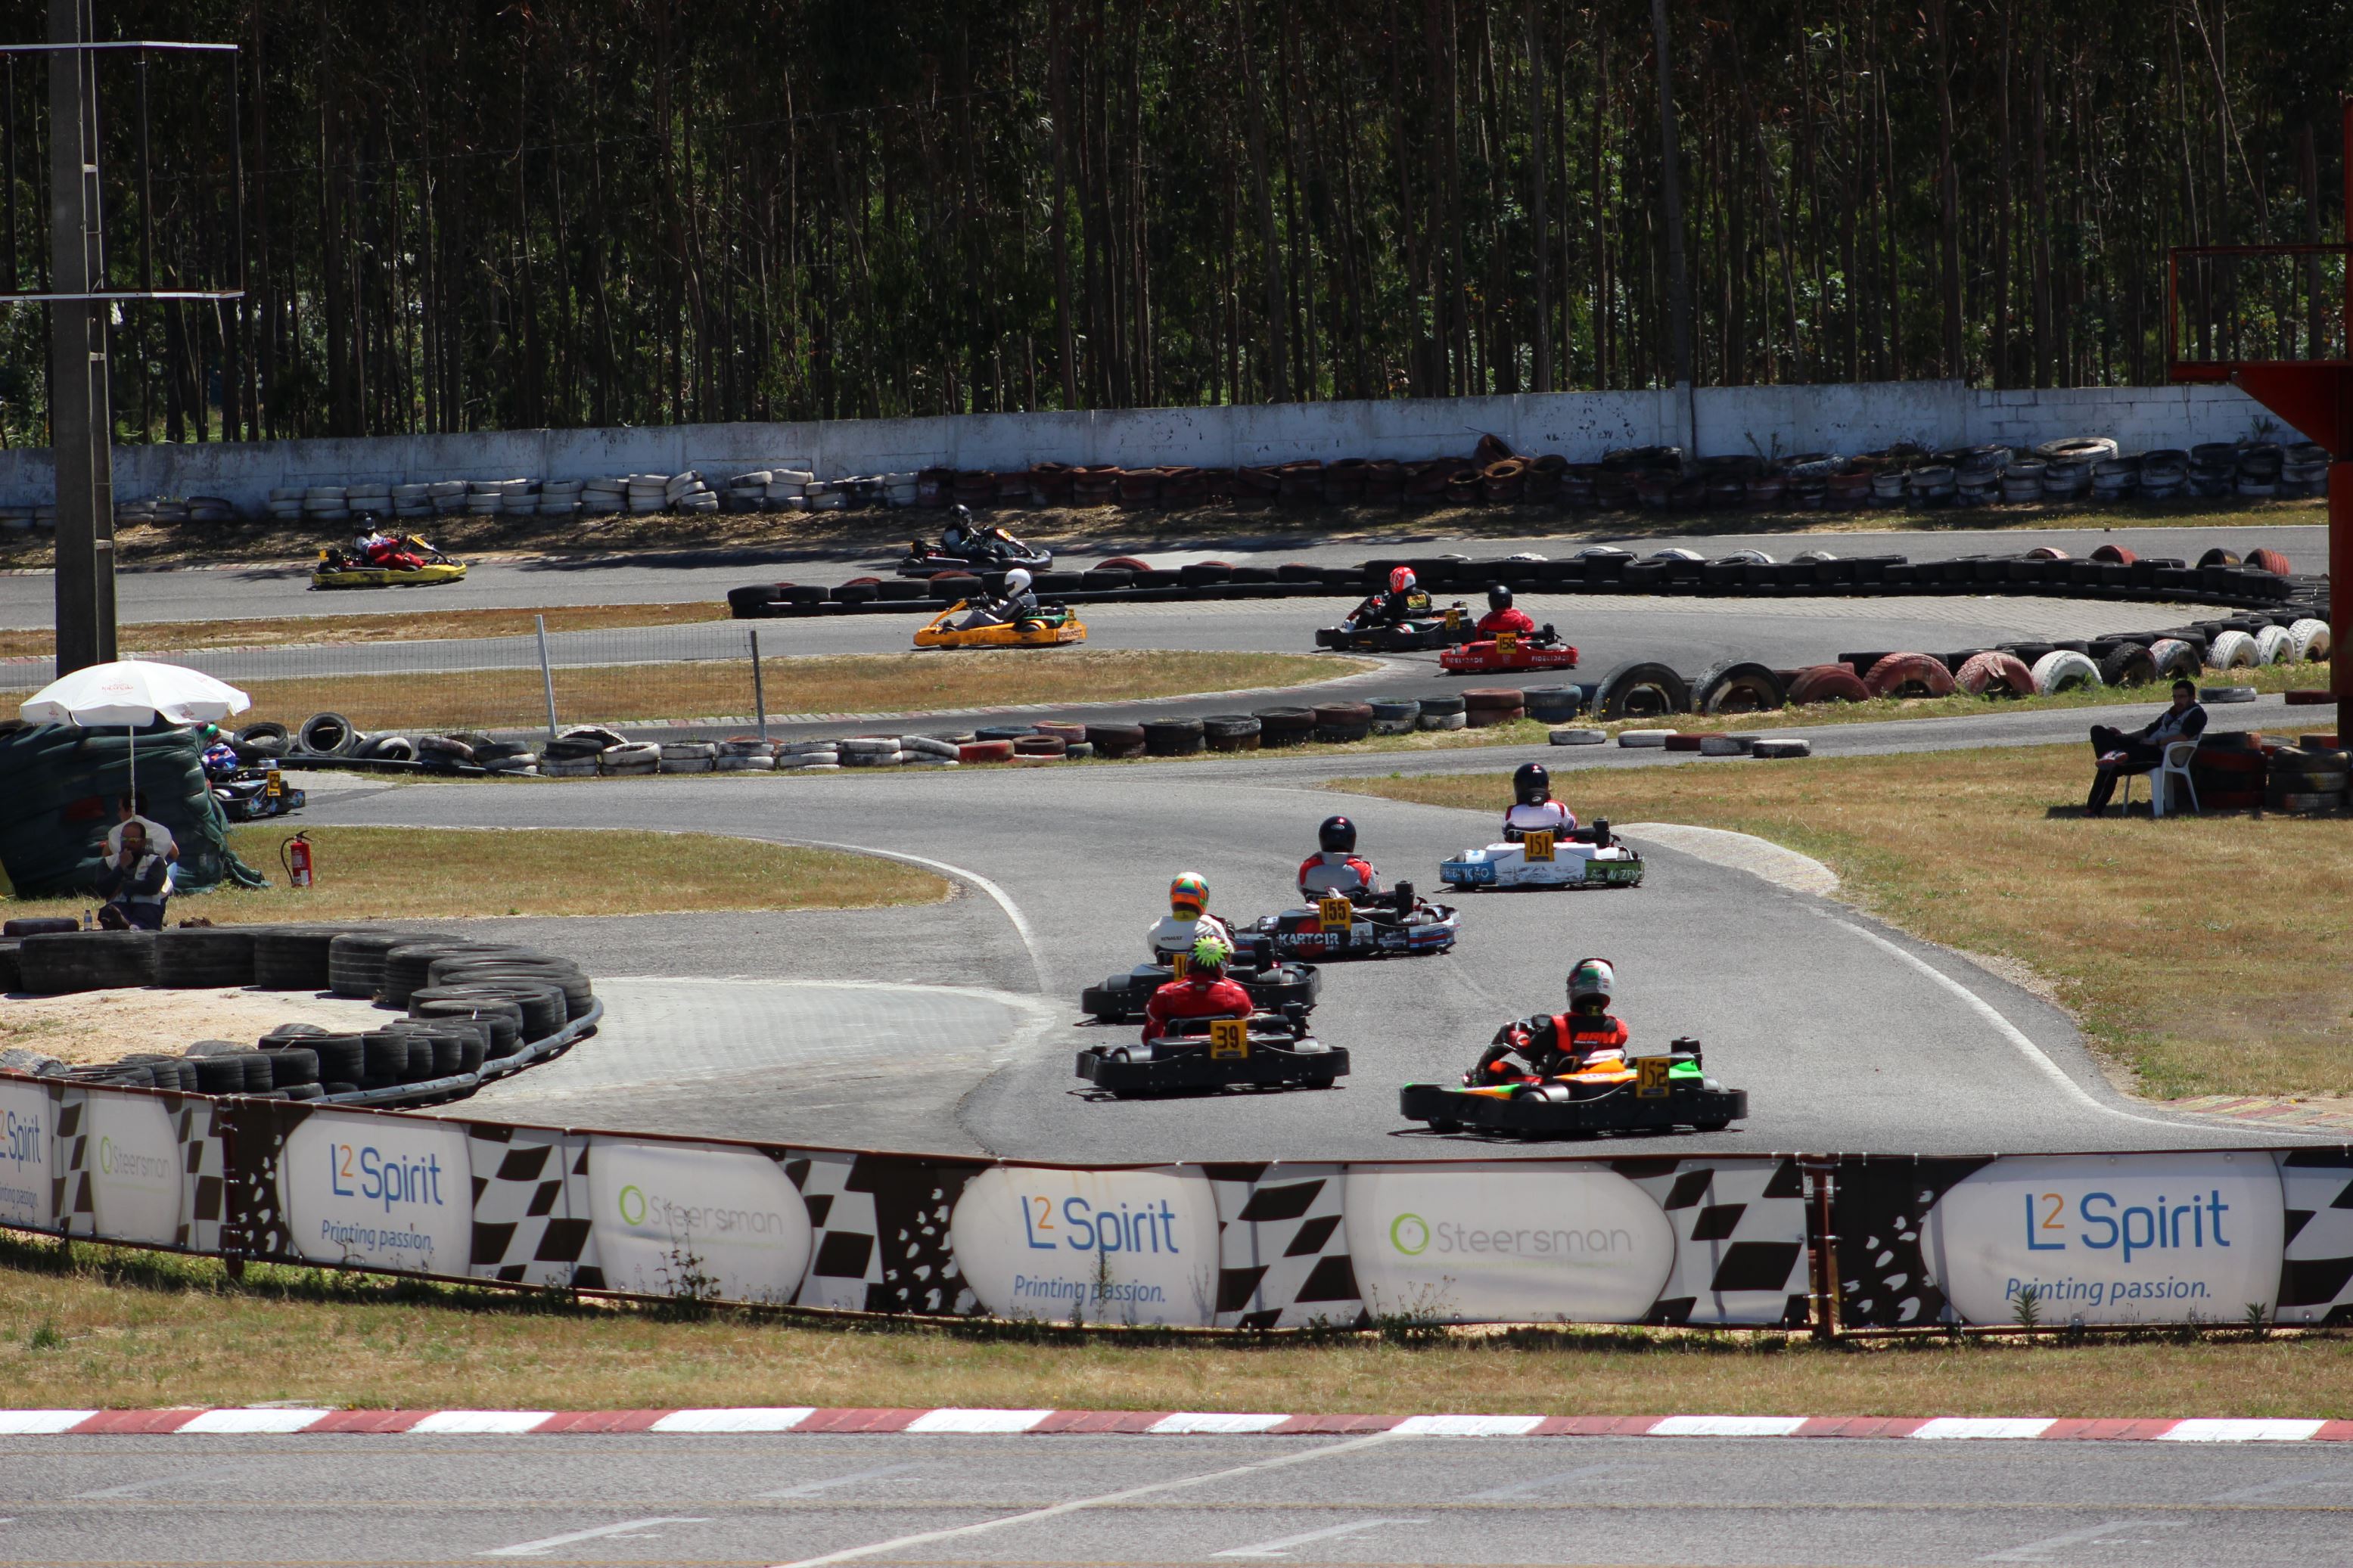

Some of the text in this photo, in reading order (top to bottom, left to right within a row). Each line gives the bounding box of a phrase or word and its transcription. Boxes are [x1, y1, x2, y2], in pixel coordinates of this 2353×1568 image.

[1500, 637, 1516, 650] 158
[1529, 834, 1549, 855] 151
[1323, 901, 1347, 921] 155
[1278, 933, 1339, 945] KARTCIR
[1216, 1025, 1239, 1049] 39
[1641, 1060, 1668, 1088] 152
[8, 1110, 42, 1172] Spirit
[114, 1144, 169, 1178] Steersman
[360, 1147, 443, 1213] Spirit
[650, 1195, 784, 1234] Steersman
[1062, 1197, 1179, 1253] Spirit
[2079, 1188, 2231, 1263] Spirit
[322, 1219, 376, 1251] Printing
[1437, 1222, 1633, 1253] Steersman
[1015, 1275, 1166, 1307] Printing passion.
[2005, 1276, 2211, 1306] Printing passion.
